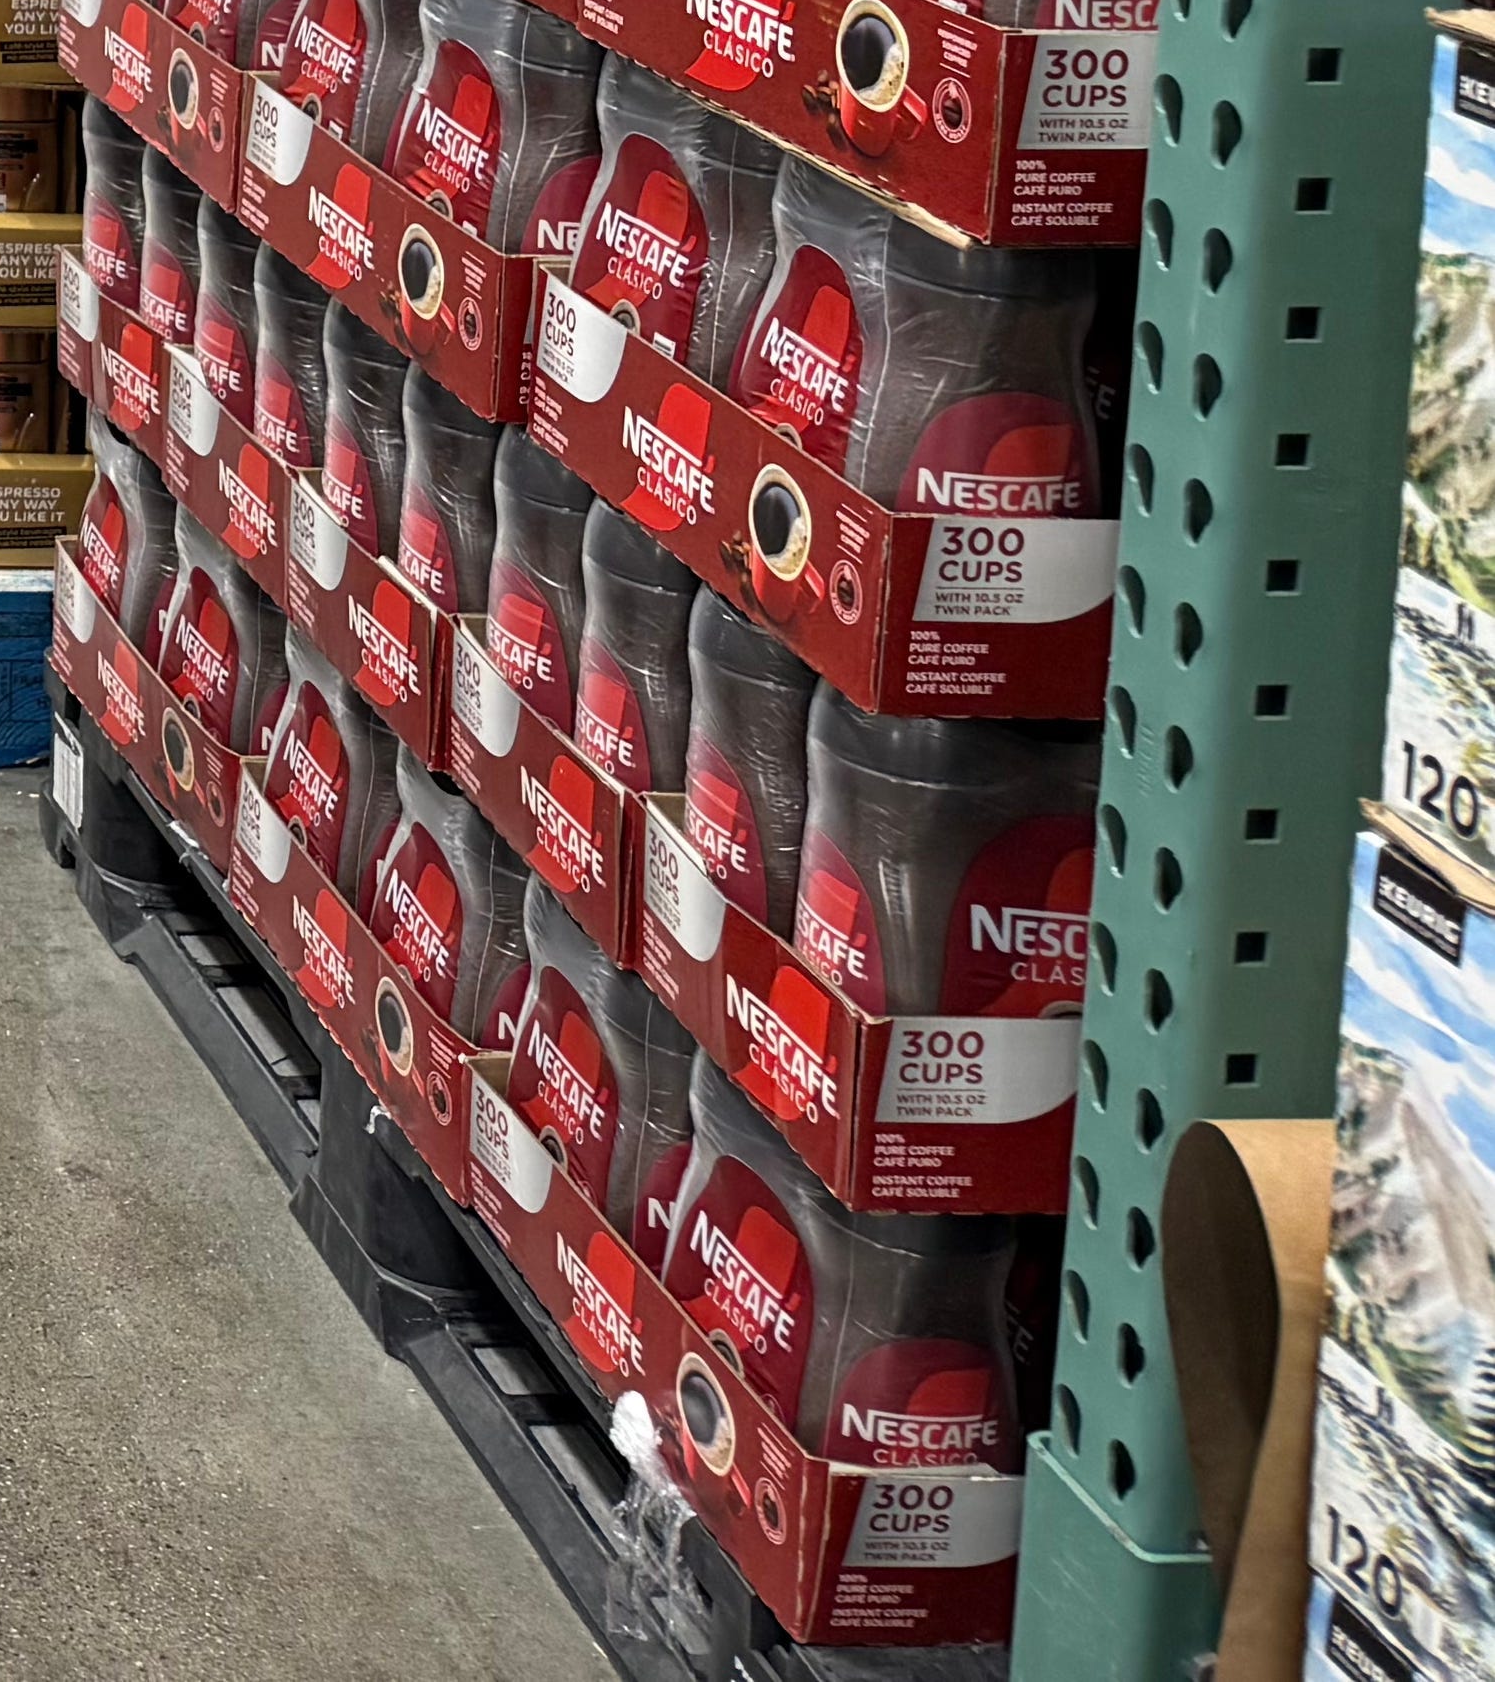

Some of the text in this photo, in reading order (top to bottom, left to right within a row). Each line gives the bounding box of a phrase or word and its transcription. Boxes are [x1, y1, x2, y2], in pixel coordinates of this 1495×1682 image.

[703, 31, 774, 78] CLÁSICO
[1045, 49, 1128, 80] 300
[1042, 84, 1127, 107] CUPS
[1039, 118, 1128, 129] WITH 10.5 OZ
[1039, 131, 1116, 143] TWIN PACK
[1015, 160, 1046, 171] 100%
[1014, 172, 1096, 183] PURE COFFEE
[1012, 203, 1113, 213] INSTANT COFFEE
[1046, 215, 1099, 226] SOLUBLE
[607, 257, 662, 300] CLÁSICO
[547, 291, 577, 334] 300
[546, 322, 575, 357] CUPS
[24, 499, 57, 510] WAY
[636, 466, 697, 525] CLÁSICO
[14, 511, 47, 522] LIKE
[51, 511, 65, 522] IT
[941, 526, 1024, 556] 300
[939, 560, 1022, 582] CUPS
[935, 592, 1024, 603] WITH 10.5 OZ
[934, 605, 1011, 616] TWIN PACK
[909, 643, 989, 654] PURE COFFEE
[1403, 740, 1479, 839] 120
[900, 1030, 984, 1059] 300
[899, 1062, 983, 1084] CUPS
[475, 1091, 508, 1137] 300
[896, 1106, 973, 1117] TWIN PACK
[475, 1120, 509, 1161] CUPS
[872, 1484, 954, 1511] 300
[869, 1514, 949, 1535] CUPS
[1327, 1504, 1401, 1618] 120
